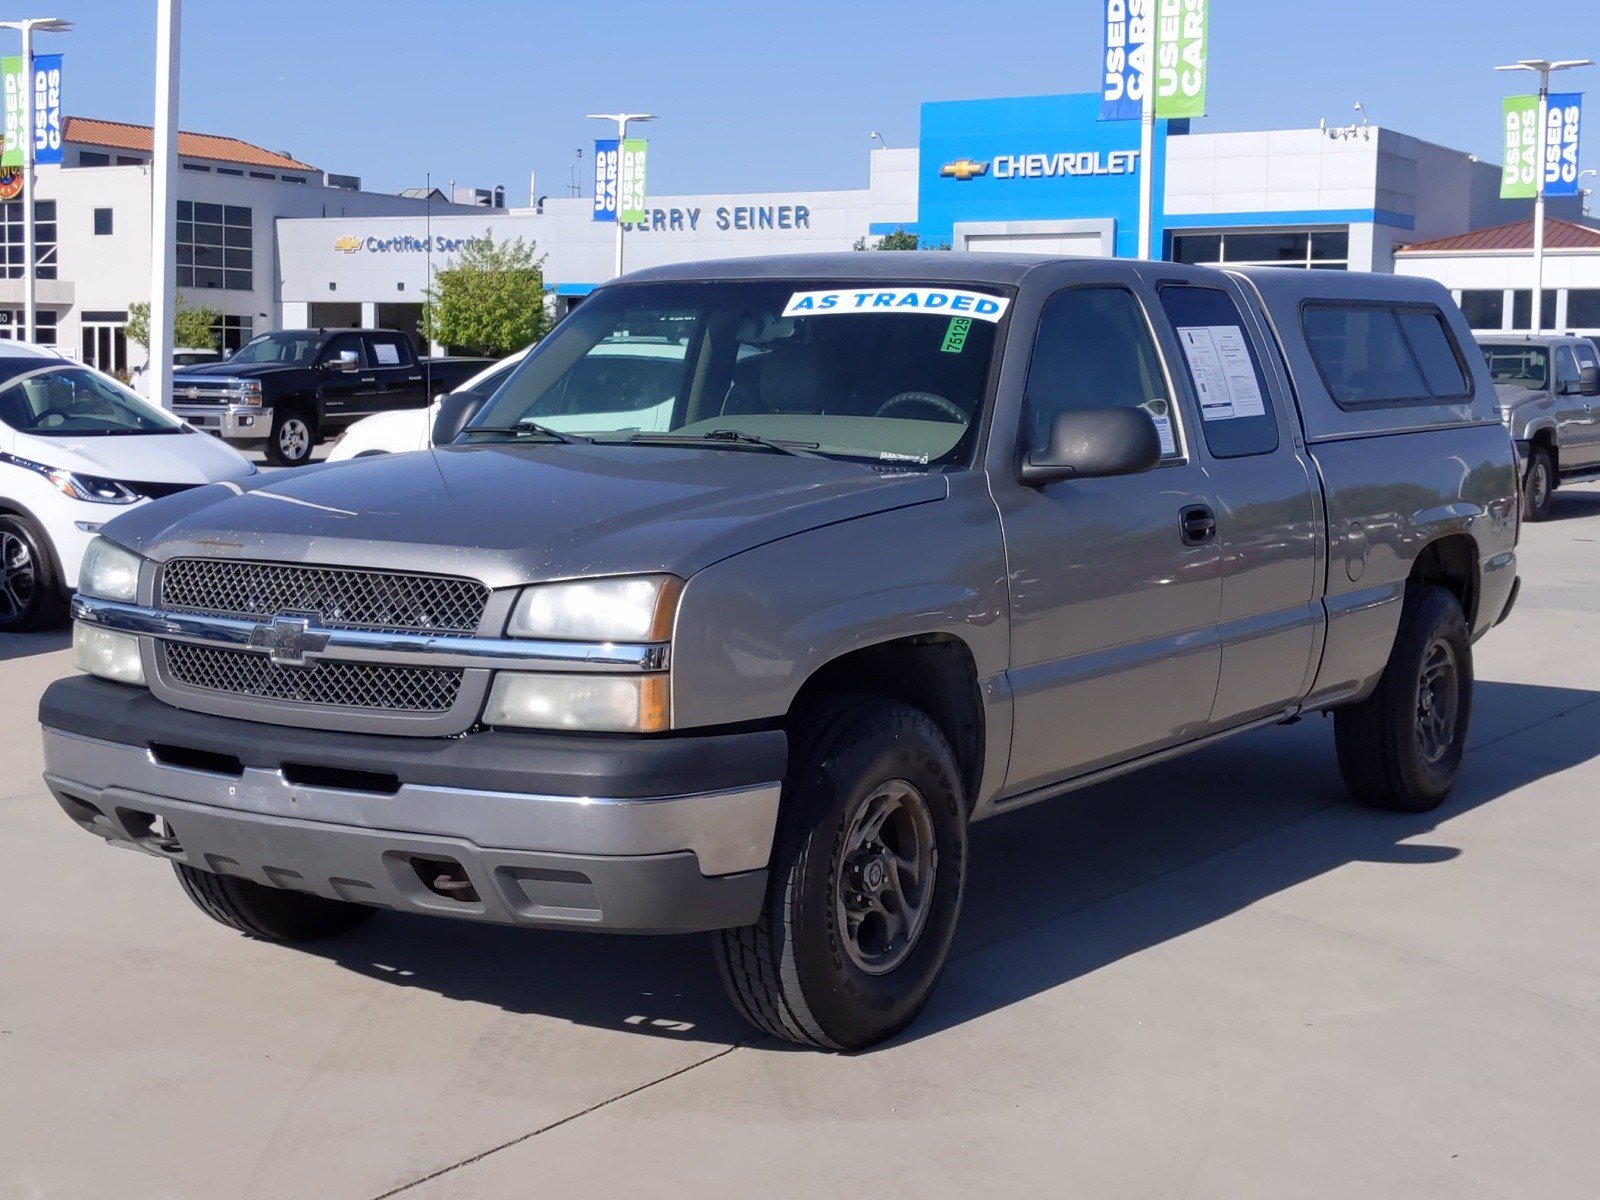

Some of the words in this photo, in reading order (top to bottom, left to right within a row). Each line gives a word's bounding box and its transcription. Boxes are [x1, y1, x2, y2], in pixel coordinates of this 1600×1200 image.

[1104, 0, 1126, 101] USED
[1158, 0, 1180, 97] USED
[5, 72, 18, 151] USED
[35, 70, 48, 150] USED
[48, 69, 60, 150] CARS
[993, 150, 1141, 179] CHEVROLET
[1505, 111, 1520, 185] USED
[1521, 109, 1536, 185] CARS
[1545, 107, 1562, 183] USED
[1562, 106, 1579, 183] CARS
[595, 151, 606, 211] USED
[606, 150, 617, 211] CARS
[622, 151, 634, 211] USED
[634, 150, 646, 211] CARS
[366, 235, 432, 253] Certified
[436, 235, 490, 253] Servi
[716, 205, 810, 231] SEINER
[791, 294, 841, 312] AS
[853, 292, 1000, 315] TRADED
[946, 318, 970, 351] 75129
